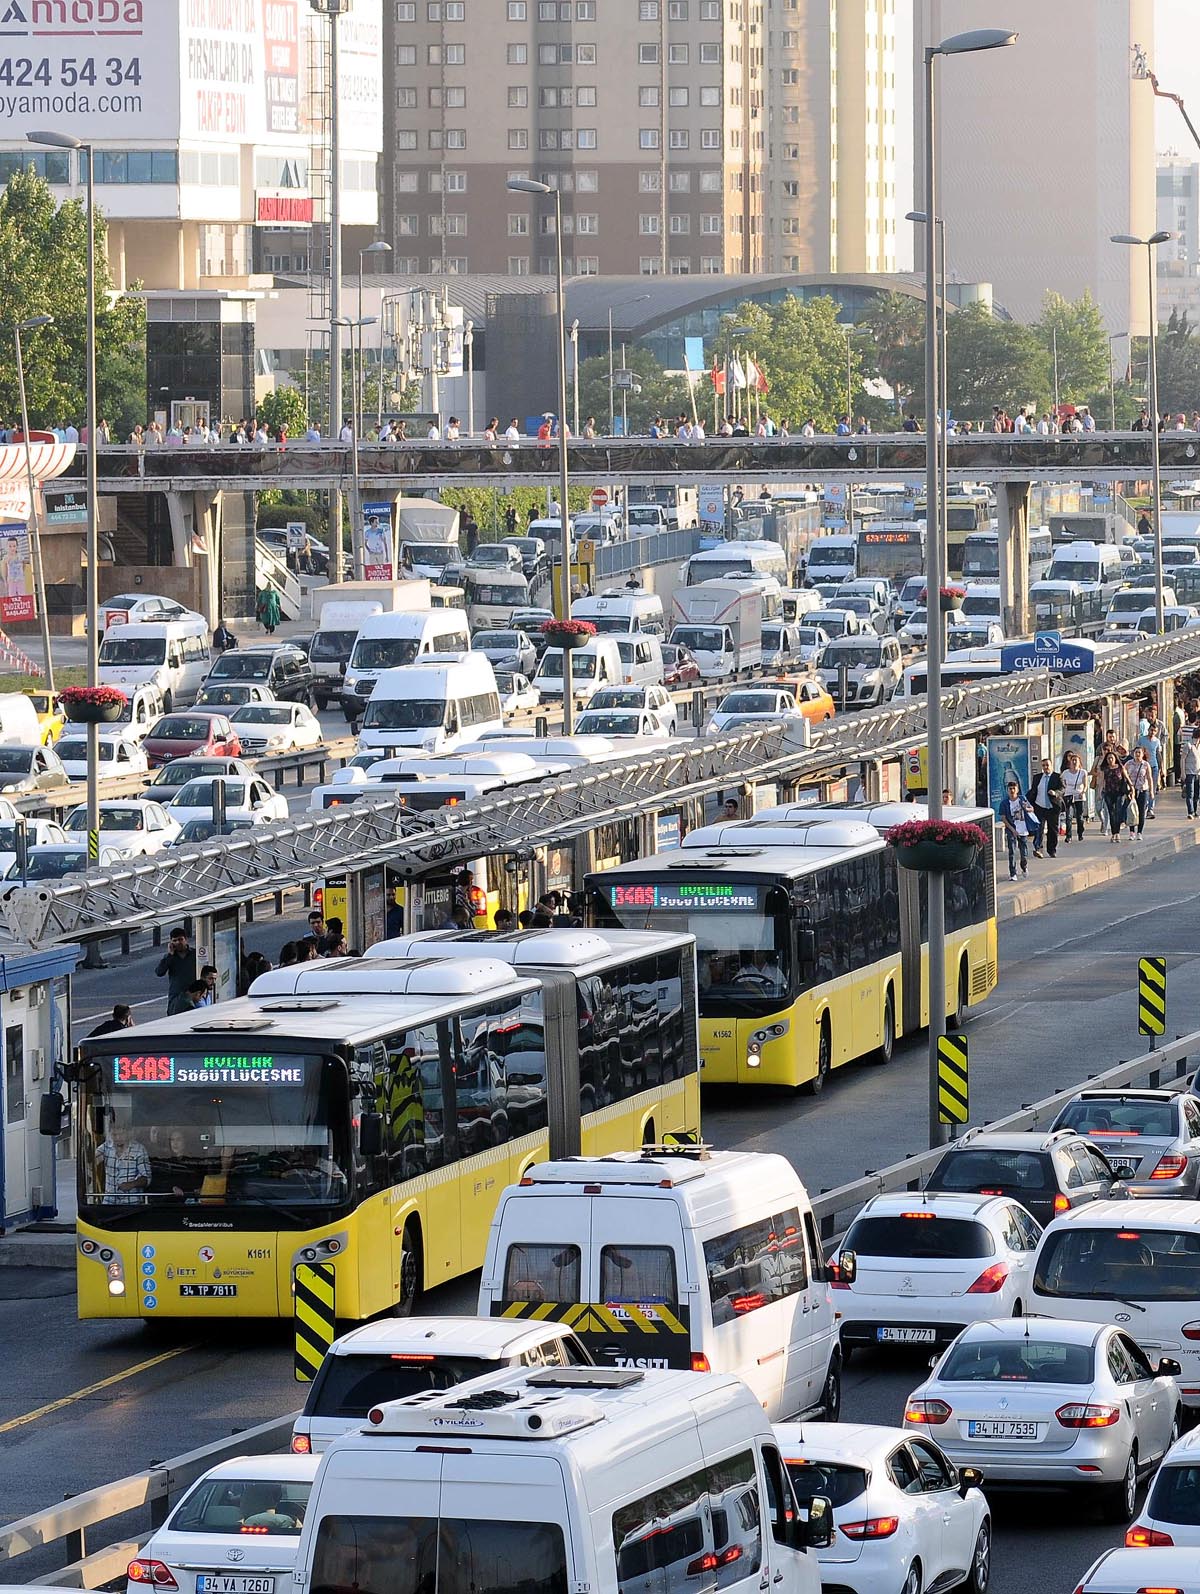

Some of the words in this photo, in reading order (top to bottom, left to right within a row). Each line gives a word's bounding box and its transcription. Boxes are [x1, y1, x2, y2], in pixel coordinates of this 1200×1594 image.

[0, 58, 52, 86] 424
[60, 58, 97, 87] 54
[105, 57, 142, 86] 34
[1014, 655, 1081, 669] CEVİZLİBAĞ
[118, 1056, 170, 1081] 34AS
[247, 1249, 271, 1258] K1611
[183, 1285, 194, 1295] 34
[198, 1286, 209, 1295] TP
[212, 1286, 234, 1295] 7811
[883, 1329, 894, 1338] 34
[897, 1329, 908, 1338] TY
[911, 1330, 932, 1339] 7771
[975, 1422, 987, 1434] 34
[992, 1423, 1005, 1434] HJ
[1009, 1423, 1035, 1435] 7535
[205, 1578, 218, 1590] 34
[223, 1579, 237, 1592] VA
[242, 1579, 270, 1592] 1260
